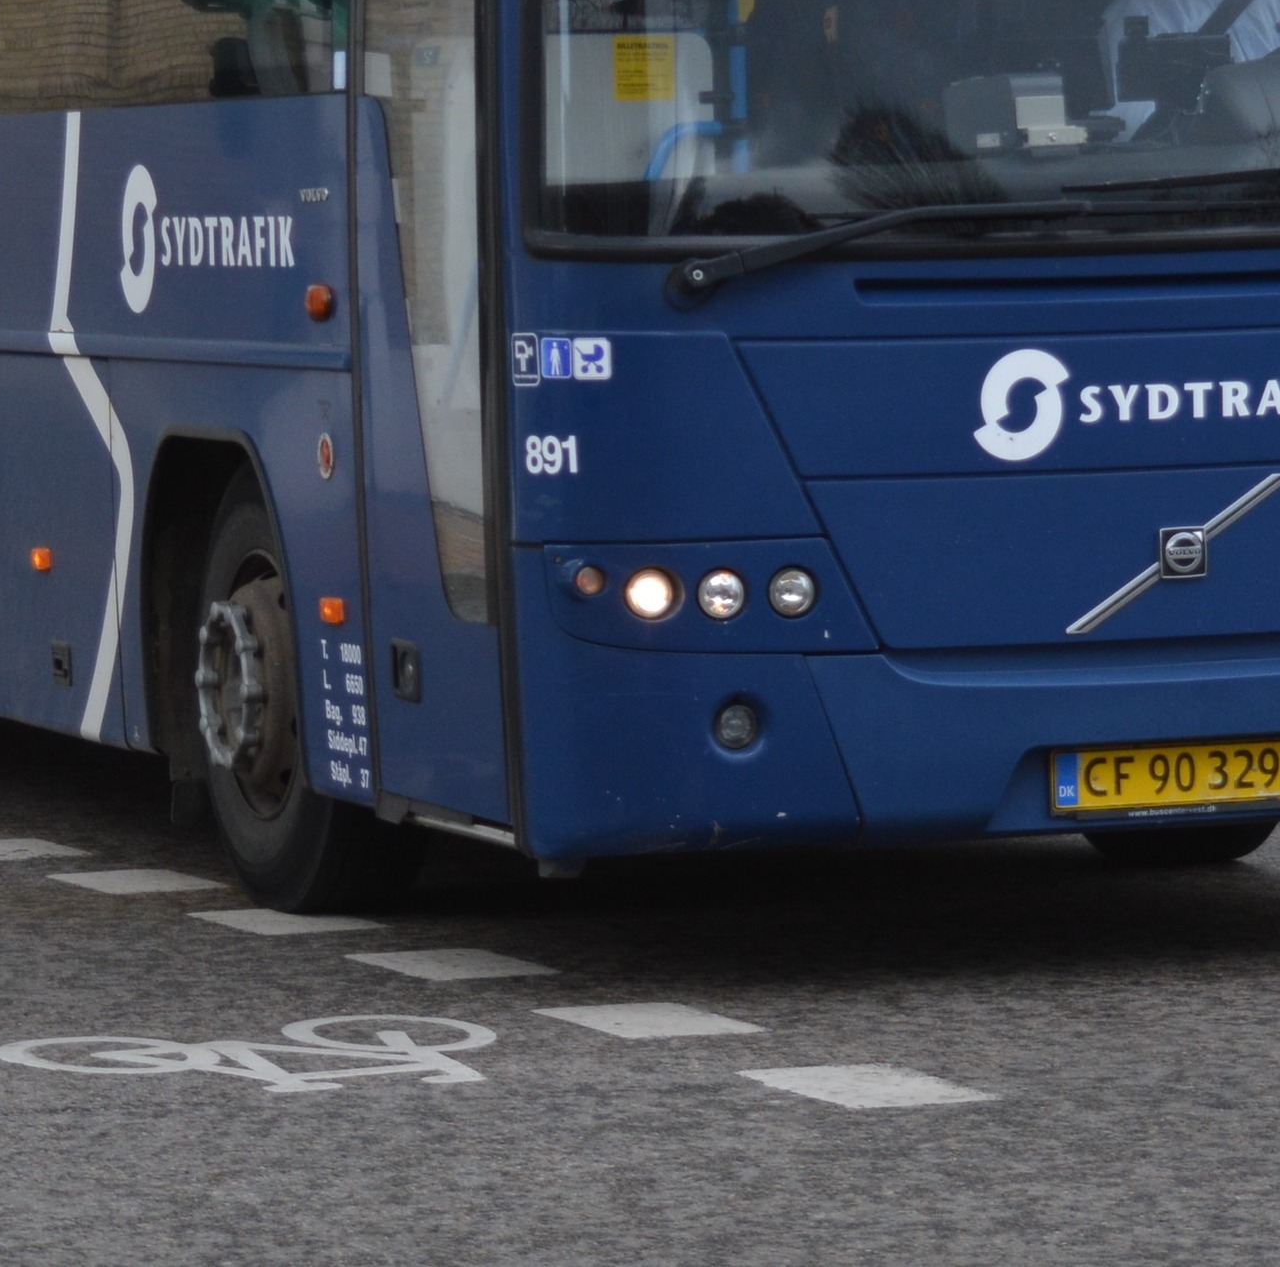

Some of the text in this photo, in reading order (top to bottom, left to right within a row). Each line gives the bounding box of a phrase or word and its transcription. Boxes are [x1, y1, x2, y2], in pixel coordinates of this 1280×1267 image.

[160, 215, 295, 268] SYDTRAFIK
[526, 435, 579, 475] 891
[1168, 546, 1201, 556] VOLVO
[321, 639, 362, 665] T. 18000
[323, 669, 364, 696] L. 6650
[325, 699, 366, 726] Bag. 938
[328, 730, 367, 758] Siddepl. 47
[331, 760, 369, 788] Ståpl. 37
[1084, 747, 1280, 796] CF 90 329
[1059, 785, 1075, 797] DK
